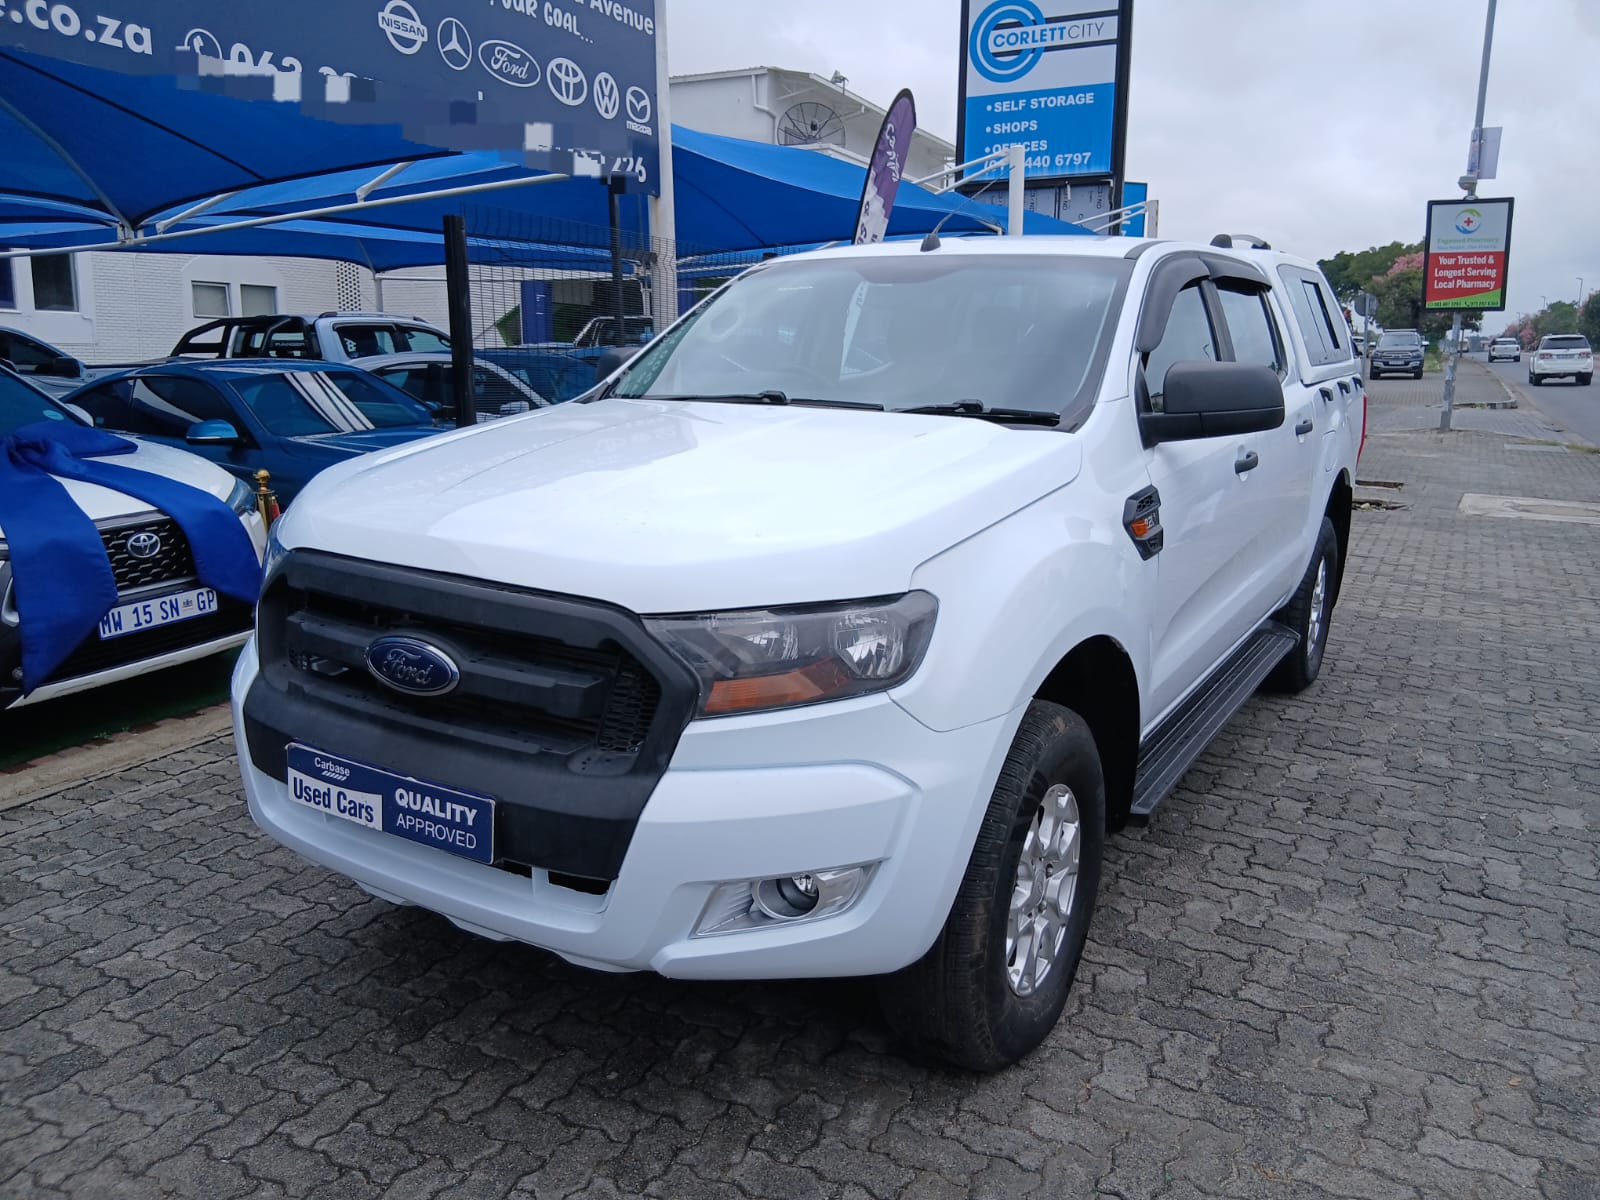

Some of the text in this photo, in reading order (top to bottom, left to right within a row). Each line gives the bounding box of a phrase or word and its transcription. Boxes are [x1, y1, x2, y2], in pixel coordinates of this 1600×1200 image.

[381, 16, 425, 37] NISSAN
[490, 0, 594, 44] OUR GOAL...
[490, 46, 530, 80] Ford
[994, 92, 1095, 113] SELF STORAGE
[993, 120, 1038, 134] SHOPS
[1024, 155, 1050, 168] 440
[1055, 152, 1091, 166] 6797
[1438, 255, 1495, 265] Your Trusted &
[1434, 267, 1497, 278] Longest Serving
[1434, 279, 1496, 290] Local Pharmacy
[132, 604, 153, 628] 15
[160, 598, 180, 620] SN
[196, 590, 215, 611] GP
[383, 648, 434, 685] Ford
[314, 757, 351, 777] Carbase
[293, 776, 374, 823] Used Cars
[395, 788, 478, 826] QUALITY
[396, 813, 477, 849] APPROVED
